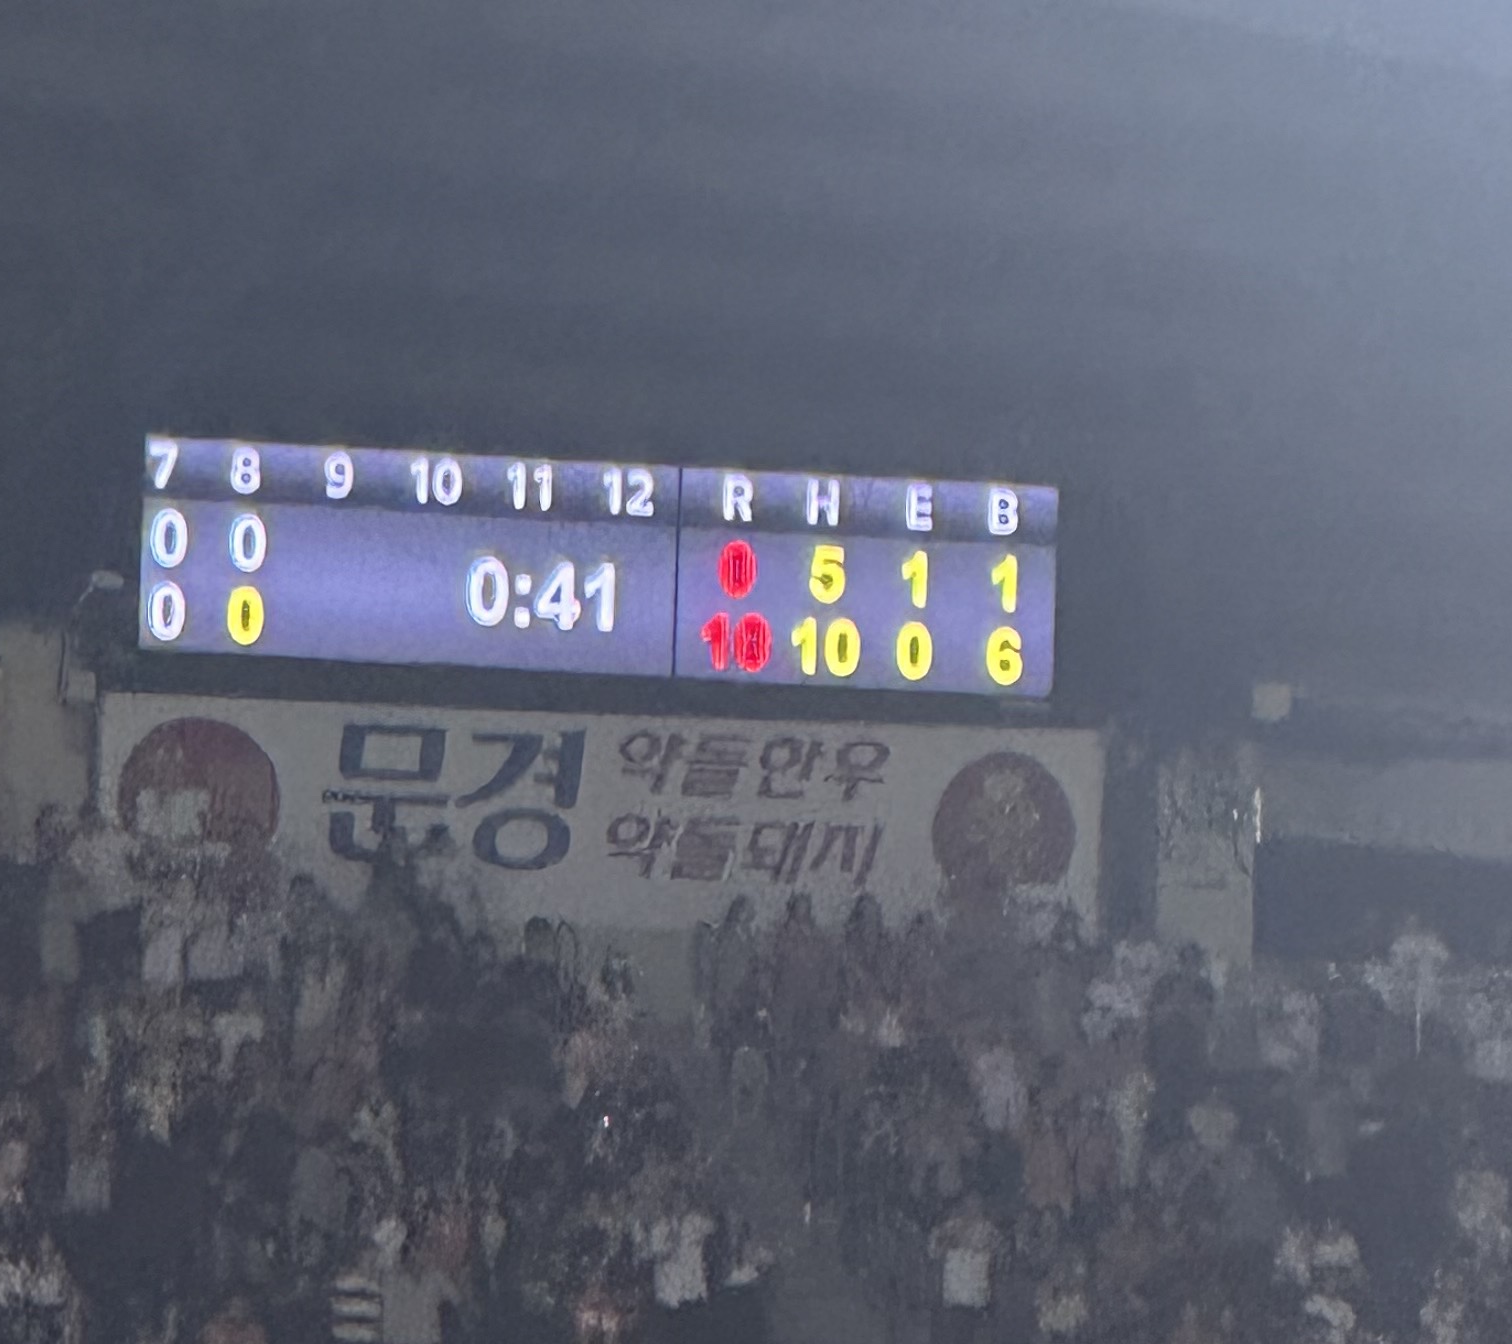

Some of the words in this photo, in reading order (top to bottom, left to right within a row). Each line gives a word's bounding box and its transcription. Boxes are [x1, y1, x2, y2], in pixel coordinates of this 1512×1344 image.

[147, 439, 178, 489] 7
[230, 445, 261, 495] 8
[324, 451, 354, 500] 9
[409, 456, 463, 506] 10
[506, 461, 554, 511] 11
[603, 465, 654, 517] 12
[722, 474, 754, 522] R
[806, 478, 840, 526] H
[905, 482, 933, 531] E
[988, 487, 1019, 535] B
[149, 507, 188, 568] 0
[229, 513, 267, 573] 0
[717, 540, 757, 599] 0
[809, 545, 846, 604] 5
[901, 550, 928, 608] 1
[991, 554, 1018, 613] 1
[464, 555, 616, 632] 0:41
[147, 580, 186, 642] 0
[227, 585, 265, 646] 0
[700, 611, 773, 673] 10
[791, 616, 861, 677] 10
[896, 621, 933, 681] 0
[986, 626, 1023, 685] 6
[321, 723, 589, 871] 문경
